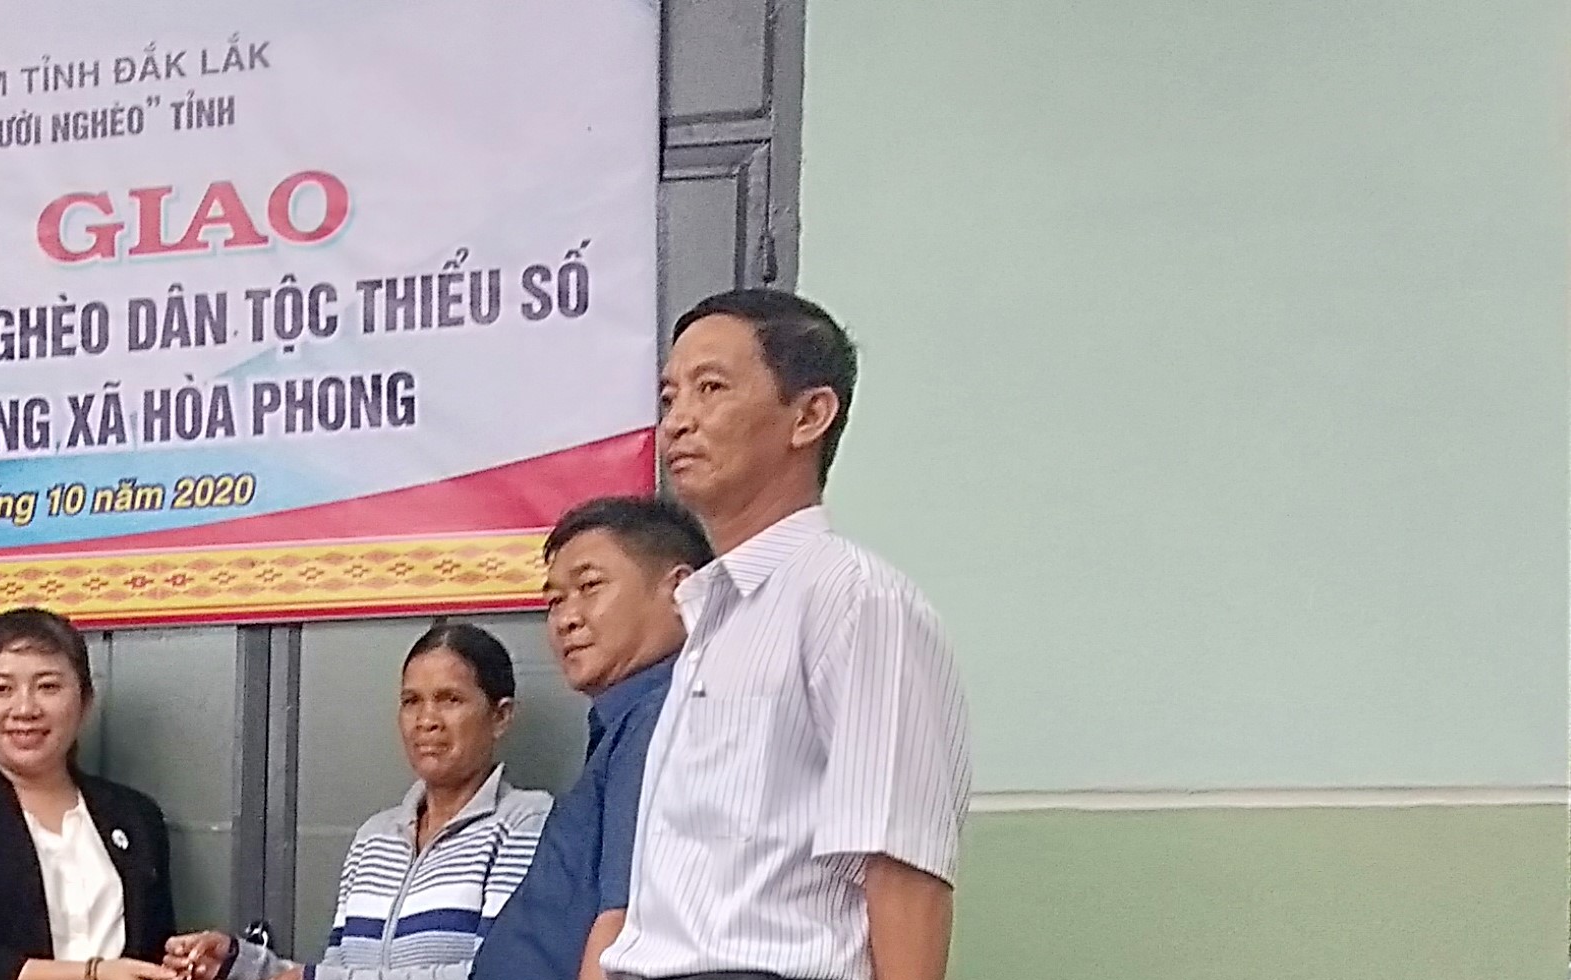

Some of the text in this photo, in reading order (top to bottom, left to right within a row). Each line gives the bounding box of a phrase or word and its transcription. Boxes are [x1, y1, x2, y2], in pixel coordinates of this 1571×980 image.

[21, 55, 100, 94] TỈNH
[114, 41, 187, 84] ĐẮK
[201, 31, 270, 76] LẮK
[170, 89, 235, 131] TỈNH
[36, 170, 349, 263] GIAO
[129, 282, 228, 351] DÂN
[245, 274, 338, 353] TỘC
[356, 246, 501, 335] THIỂU
[520, 238, 591, 321] SỐ
[67, 381, 126, 448] XÃ
[143, 374, 236, 442] HÒA
[252, 371, 416, 436] PHONG
[48, 483, 87, 516] 10
[91, 477, 165, 515] năm
[171, 472, 257, 509] 2020
